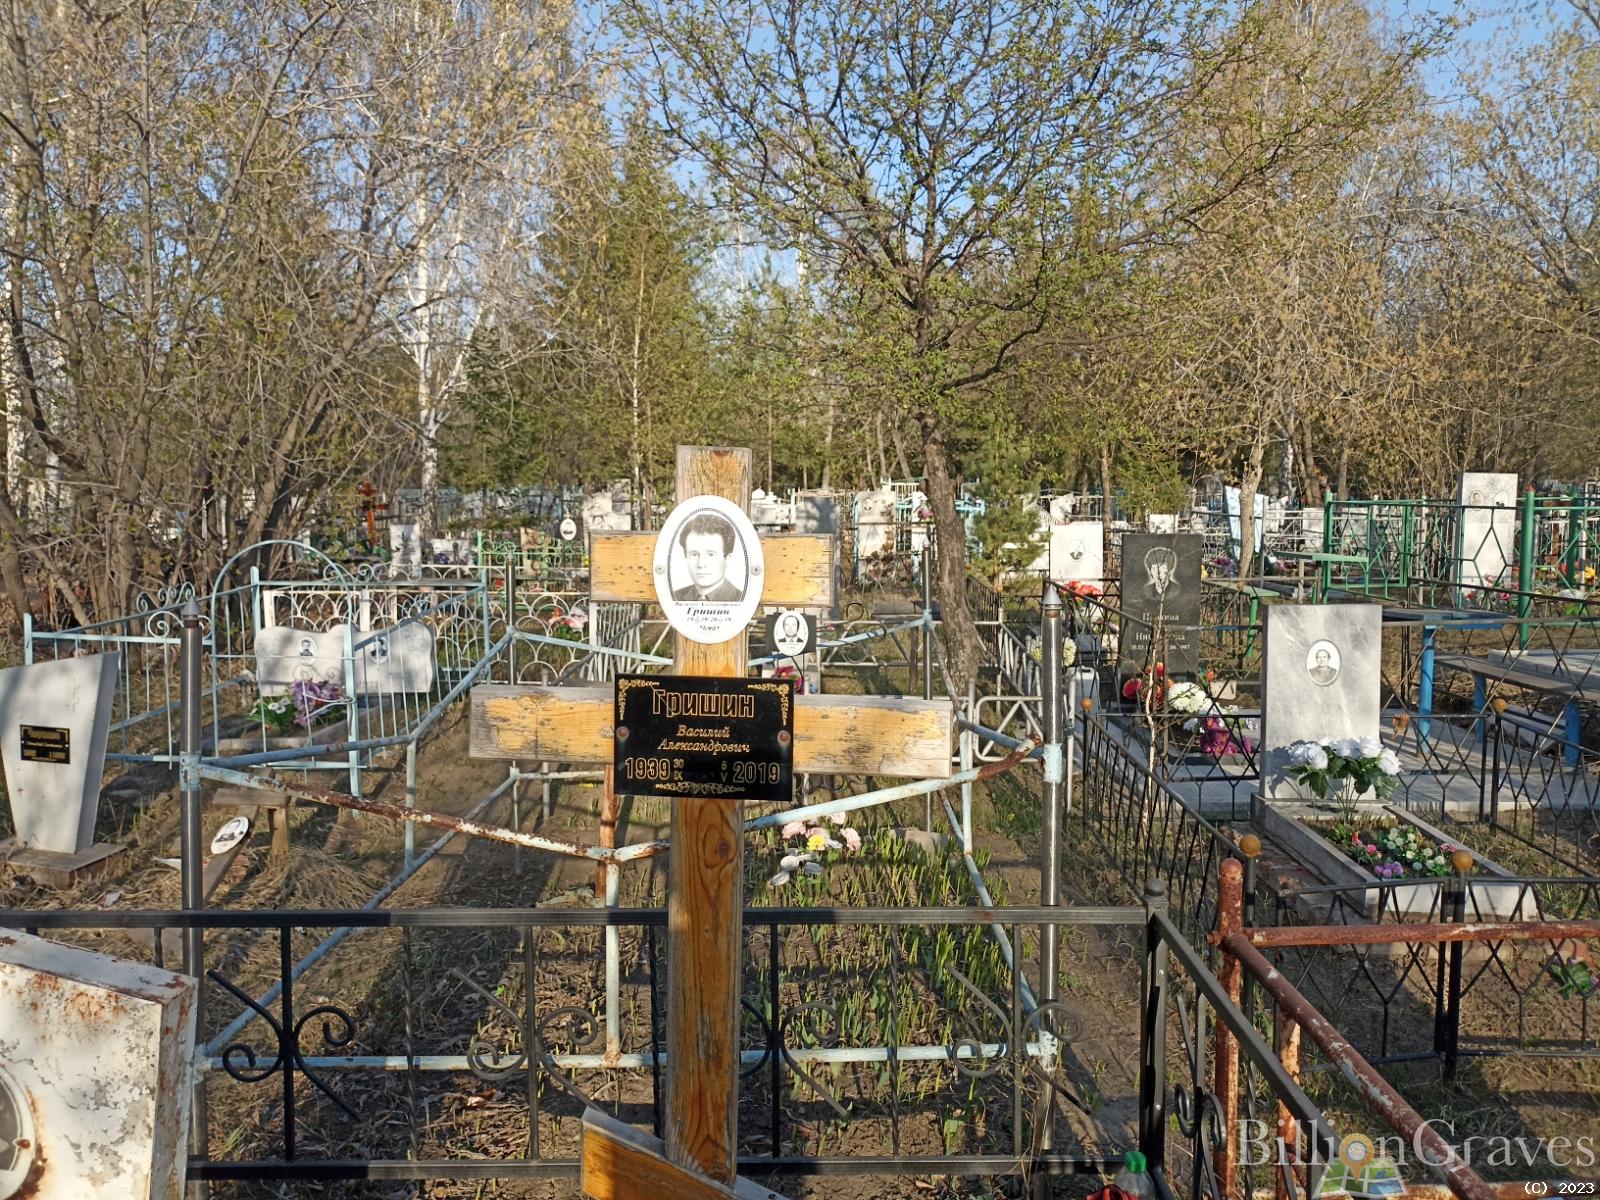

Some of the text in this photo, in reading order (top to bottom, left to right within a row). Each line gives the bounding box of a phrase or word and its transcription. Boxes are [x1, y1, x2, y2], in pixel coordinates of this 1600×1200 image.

[652, 688, 755, 718] Гришин
[676, 724, 731, 738] Василий
[657, 738, 751, 756] Александрович
[625, 757, 671, 780] 1939
[672, 758, 685, 769] 30
[733, 761, 780, 784] 2019
